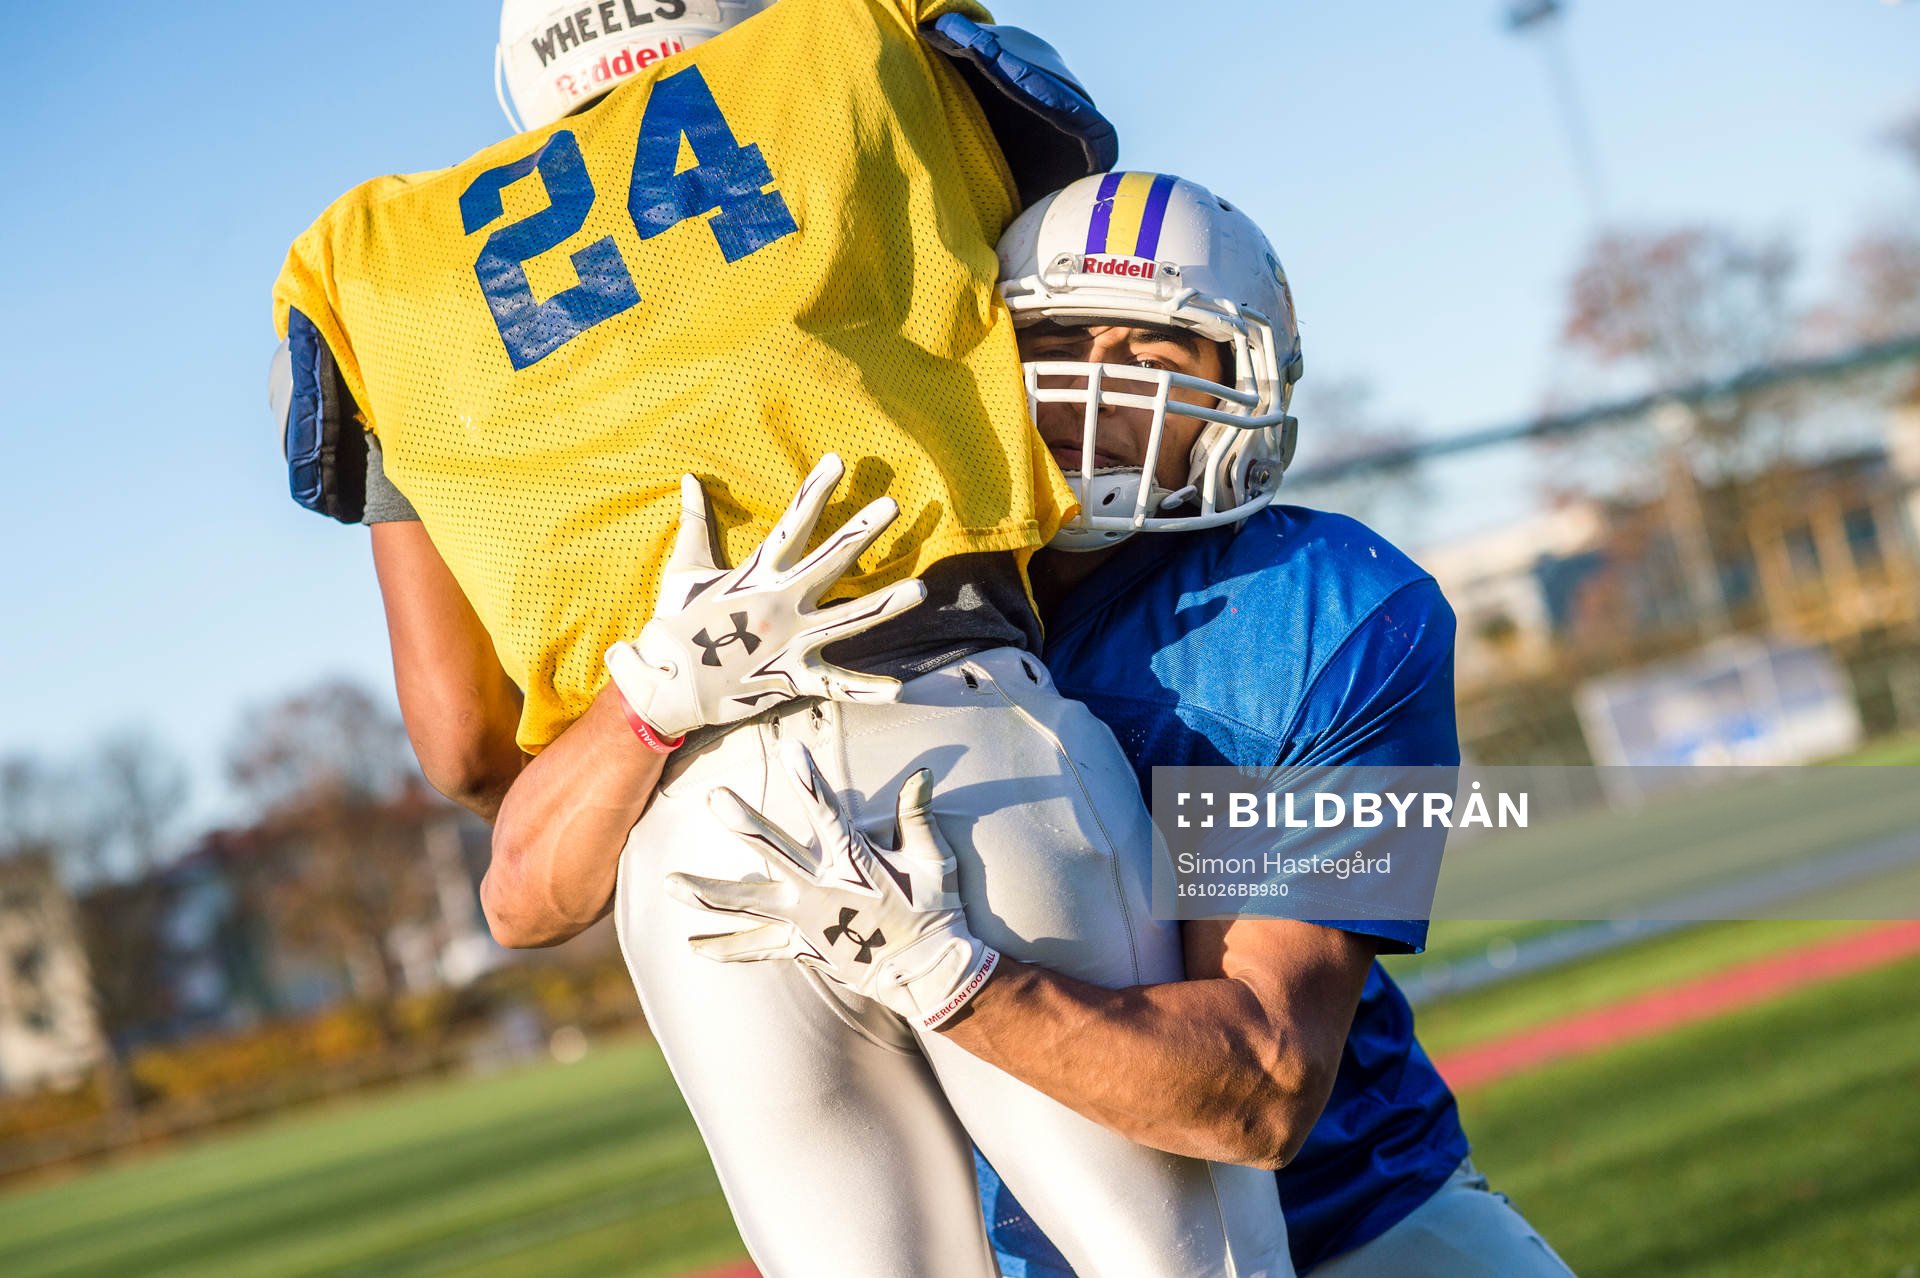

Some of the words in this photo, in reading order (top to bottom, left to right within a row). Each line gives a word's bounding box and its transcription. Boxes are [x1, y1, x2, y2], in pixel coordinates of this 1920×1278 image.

[531, 0, 687, 67] WHEELS
[458, 63, 800, 372] 24
[1082, 257, 1155, 278] Riddell
[923, 991, 968, 1027] AMERICAN
[966, 952, 996, 994] FOOTBALL
